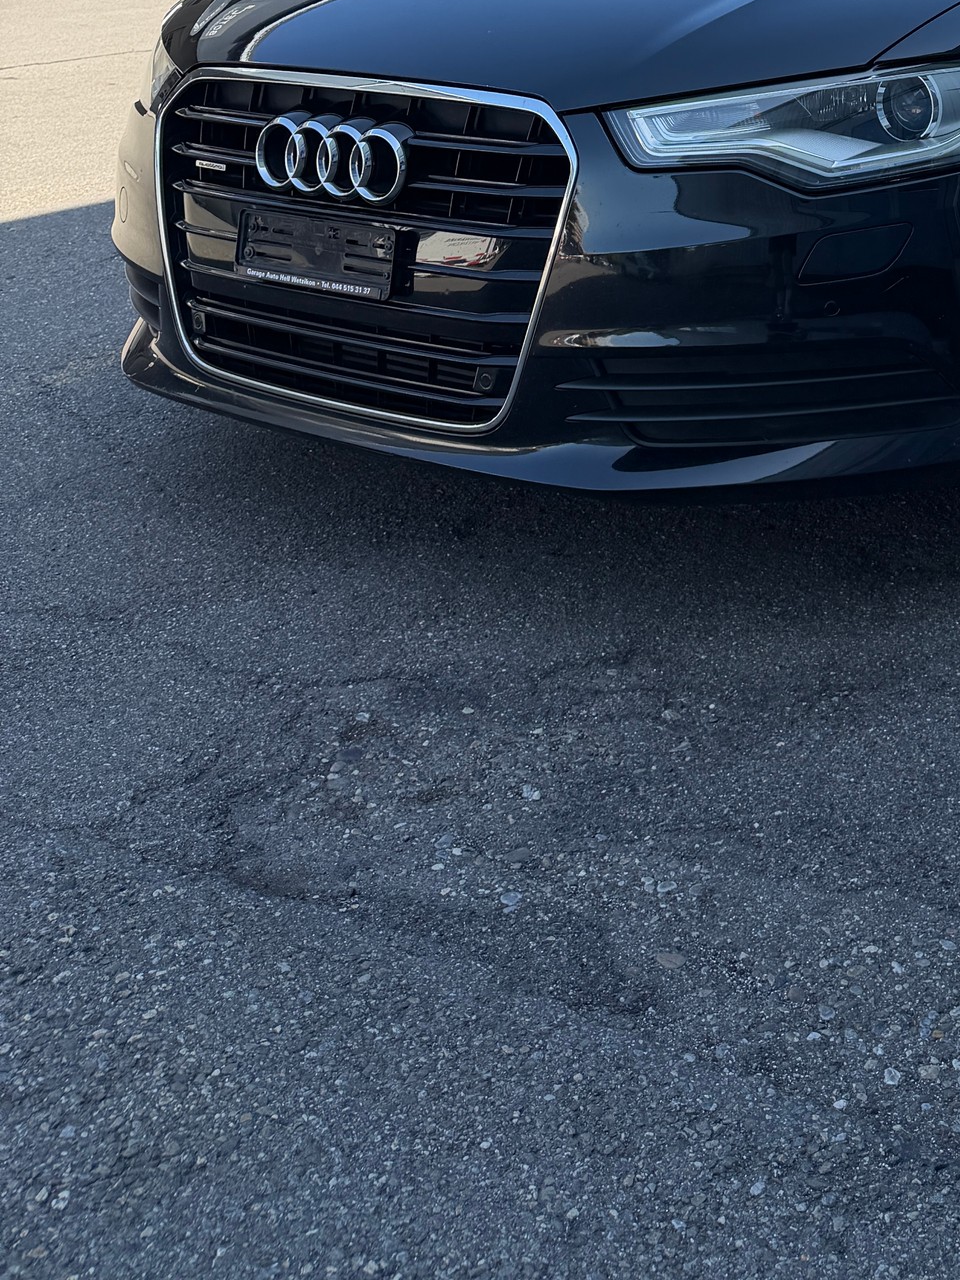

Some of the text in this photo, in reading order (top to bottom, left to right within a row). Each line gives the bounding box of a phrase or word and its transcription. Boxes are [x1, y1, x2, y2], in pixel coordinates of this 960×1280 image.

[246, 268, 265, 278] Garage
[265, 271, 279, 280] Auto
[291, 276, 316, 287] Wetzikon
[321, 281, 332, 289] Tel.
